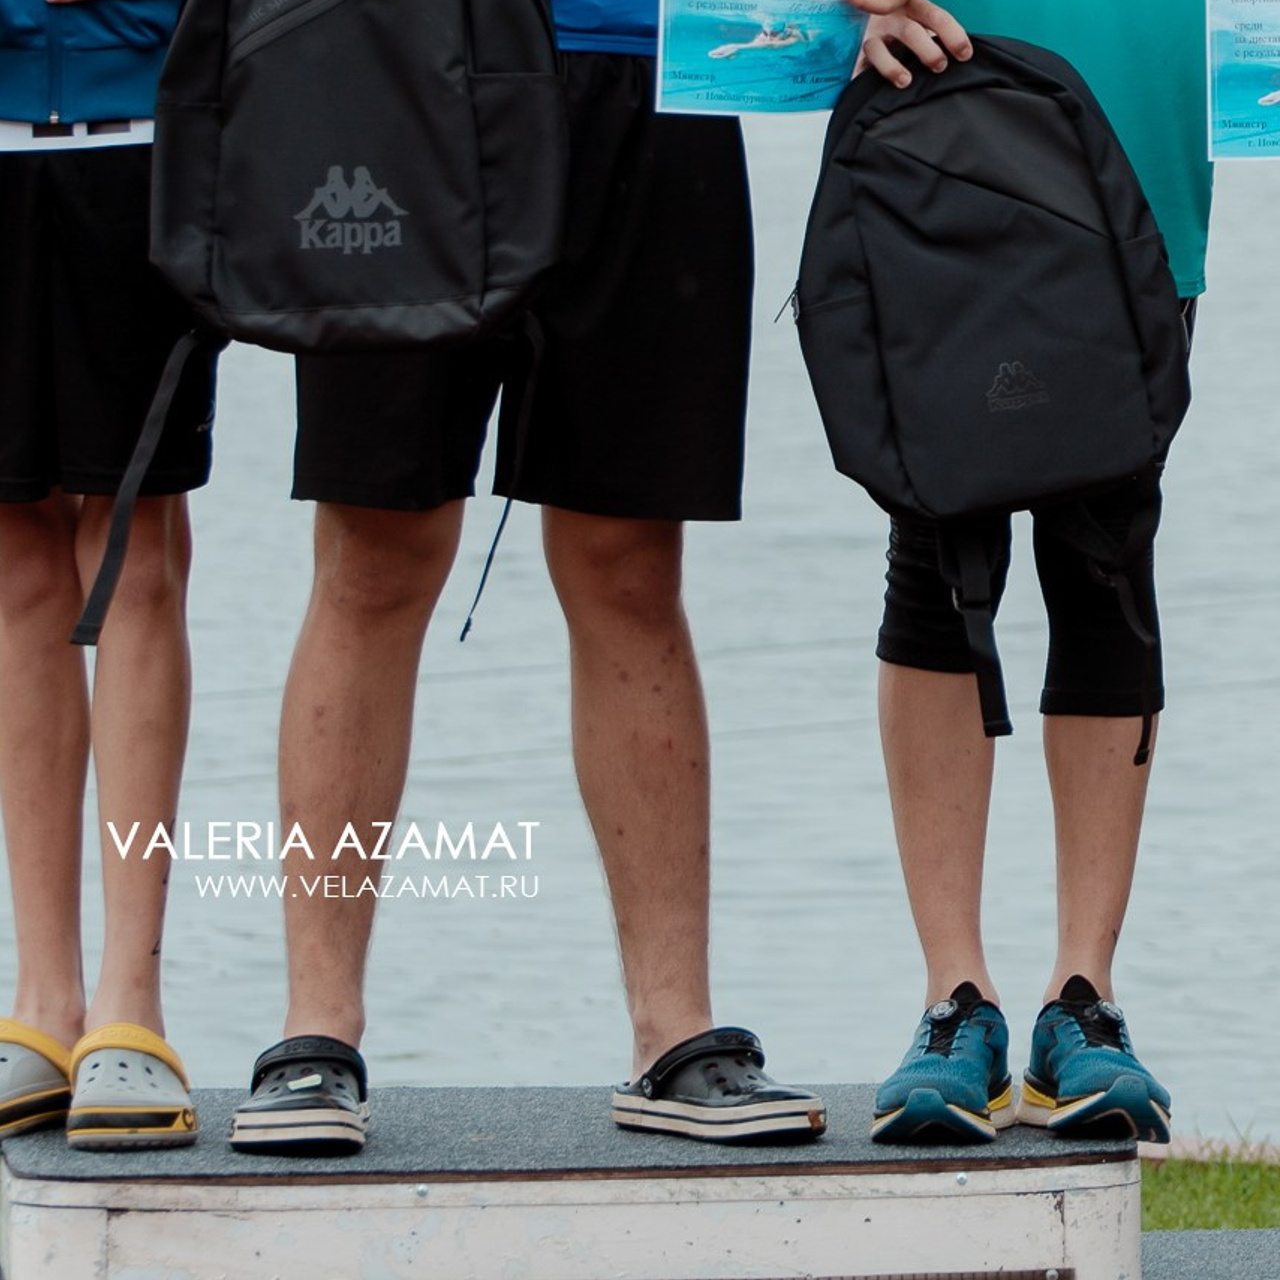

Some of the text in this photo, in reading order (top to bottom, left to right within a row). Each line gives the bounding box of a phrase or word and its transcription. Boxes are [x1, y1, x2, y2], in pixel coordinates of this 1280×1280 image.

[1234, 21, 1263, 32] среди
[1222, 120, 1267, 130] Министр
[299, 219, 403, 254] Kappa
